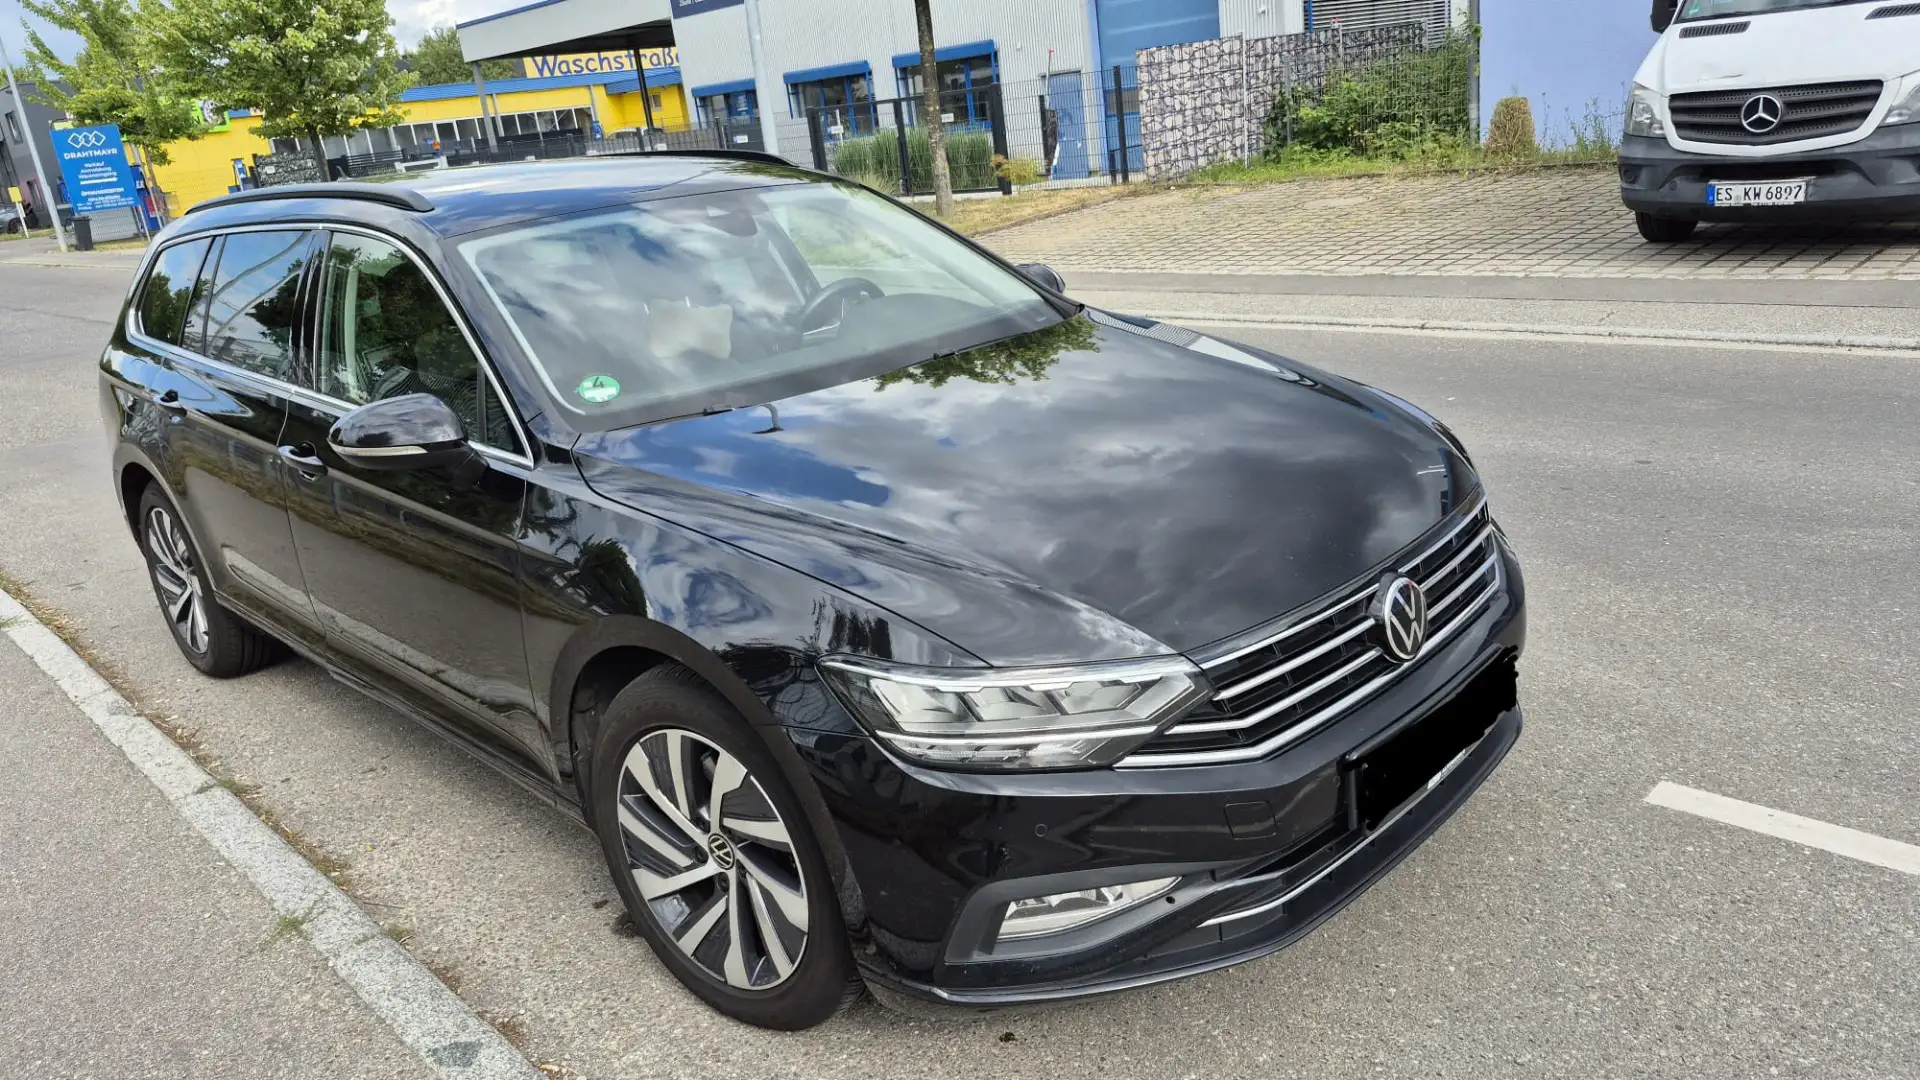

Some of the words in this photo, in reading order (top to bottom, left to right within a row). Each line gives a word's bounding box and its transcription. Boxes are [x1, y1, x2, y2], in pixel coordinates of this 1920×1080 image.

[531, 47, 680, 77] Waschstraß
[63, 147, 118, 160] DRAHTMAYR
[1716, 187, 1733, 201] ES
[1743, 186, 1762, 201] KW
[1765, 185, 1802, 200] 6897
[592, 376, 605, 388] 4
